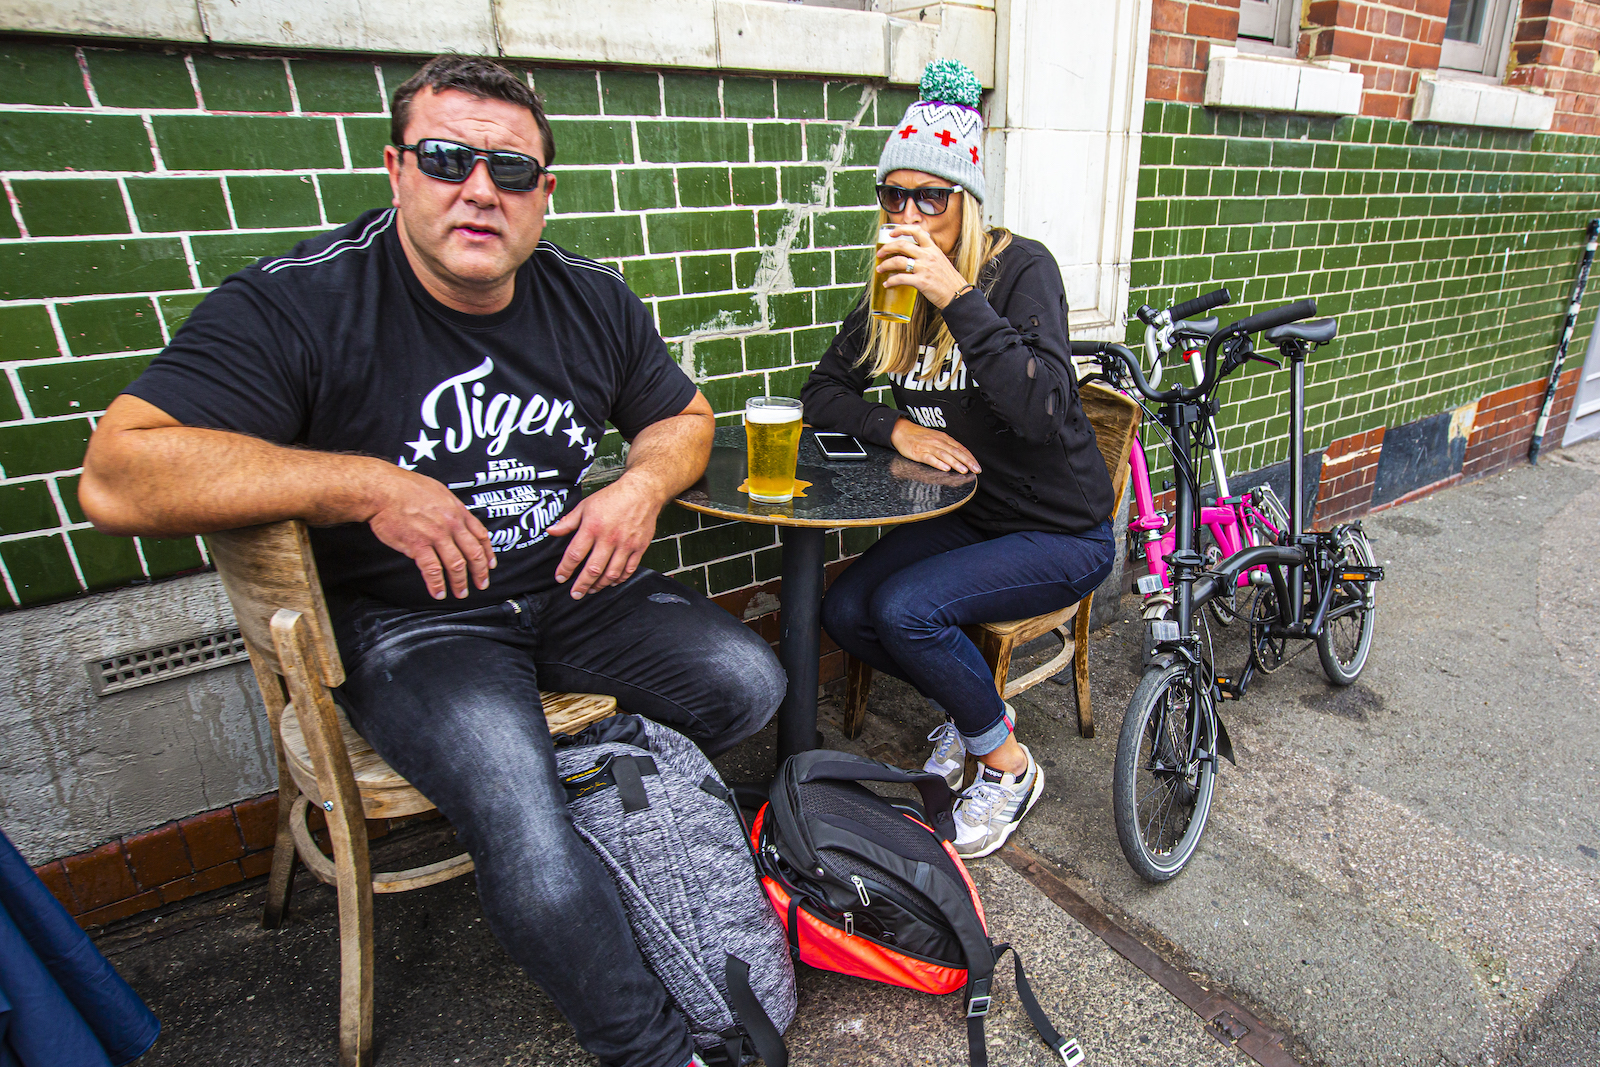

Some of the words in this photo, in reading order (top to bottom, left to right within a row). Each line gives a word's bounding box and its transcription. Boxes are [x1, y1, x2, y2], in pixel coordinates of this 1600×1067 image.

[420, 356, 575, 457] Tiger
[488, 458, 524, 471] EST.
[488, 526, 523, 552] ay
